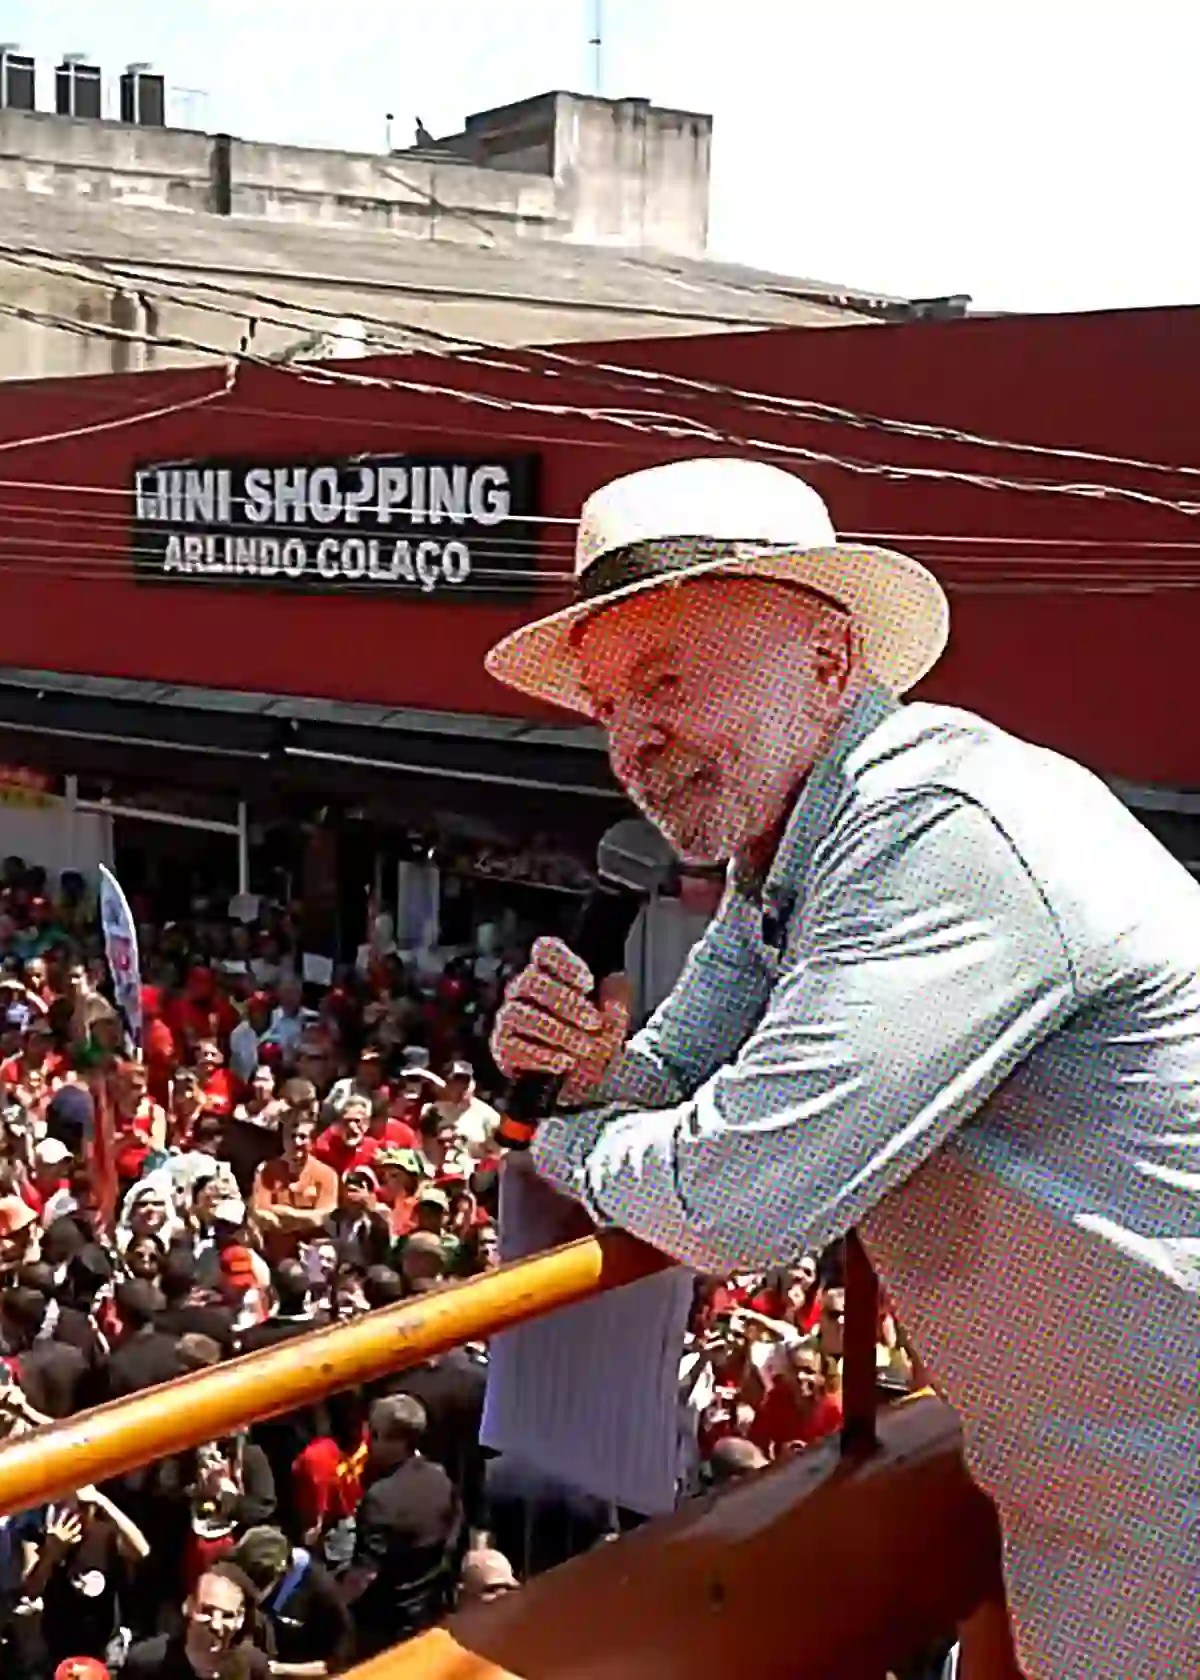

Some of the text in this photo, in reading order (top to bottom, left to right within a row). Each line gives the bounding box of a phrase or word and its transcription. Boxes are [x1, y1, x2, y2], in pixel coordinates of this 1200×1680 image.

[244, 466, 511, 526] SHOPPING
[163, 535, 471, 592] ARLINDO COLAÇO
